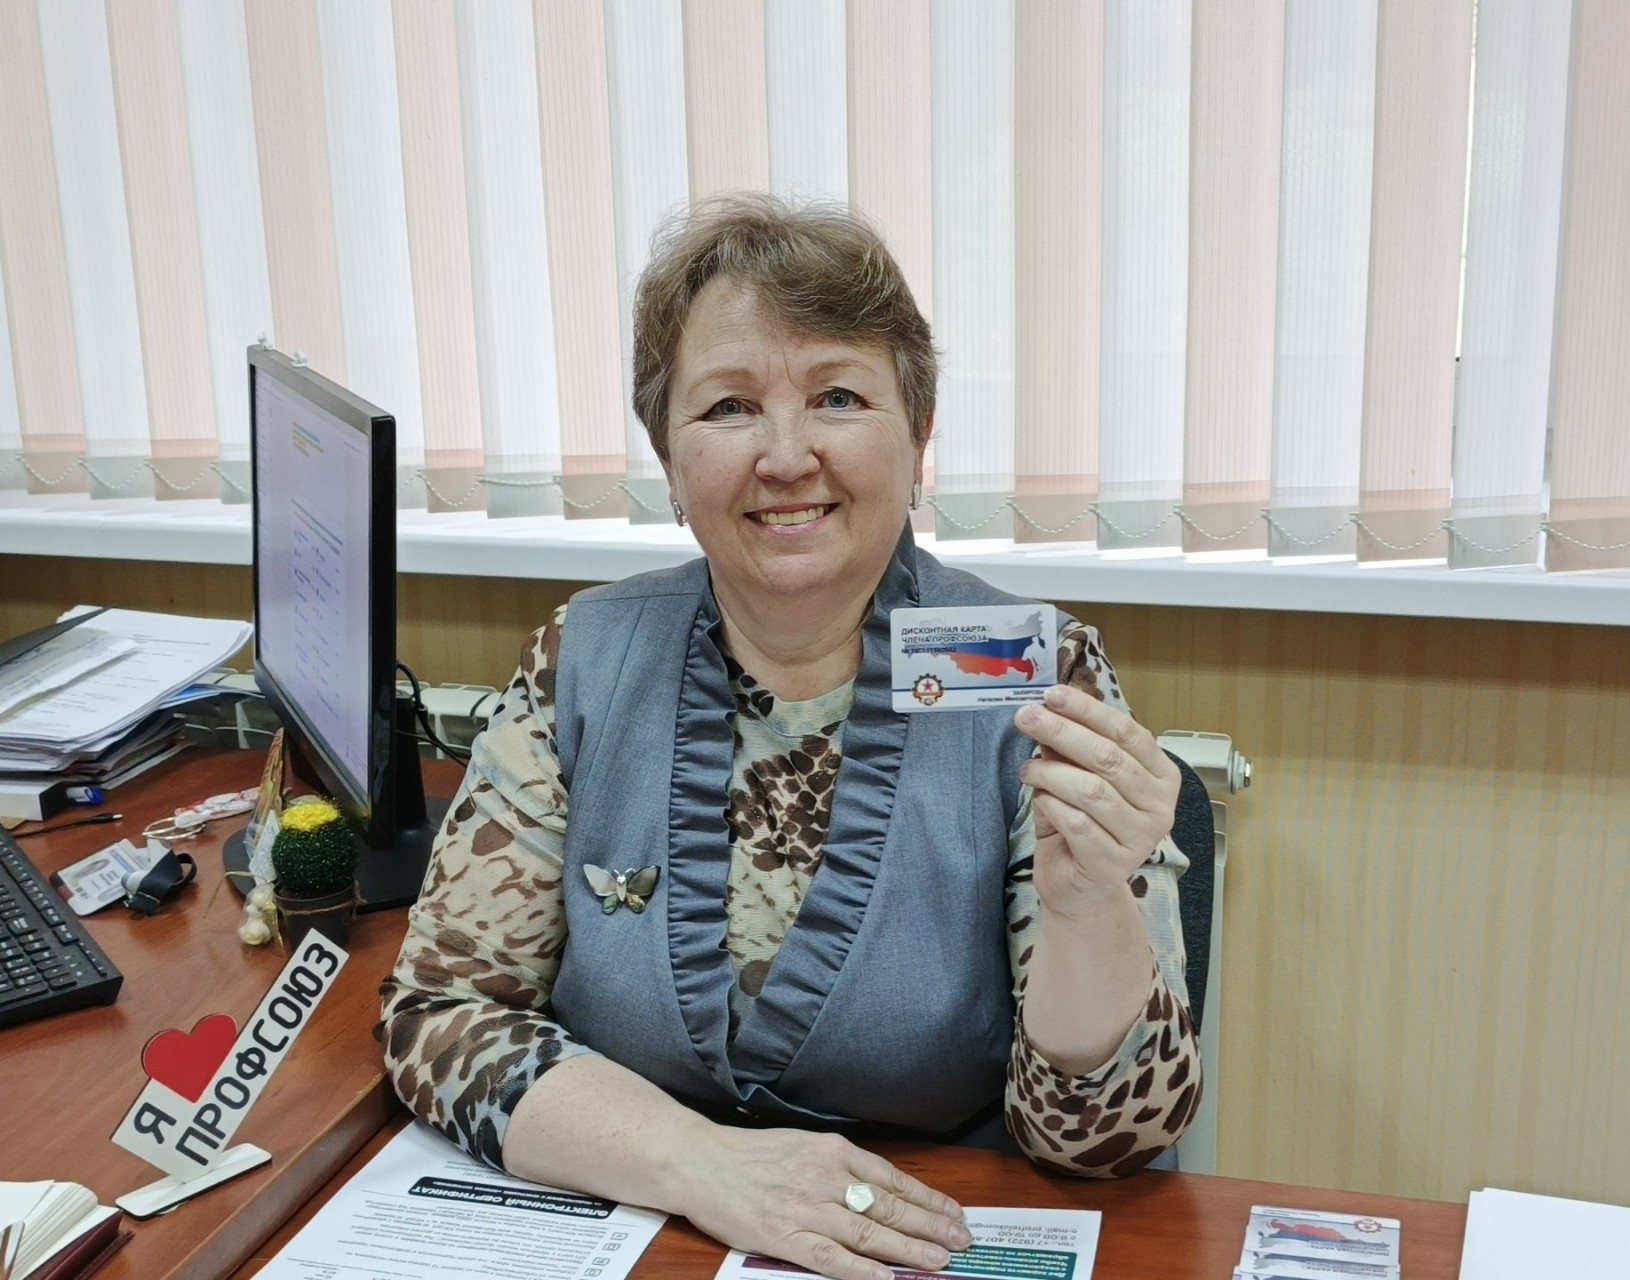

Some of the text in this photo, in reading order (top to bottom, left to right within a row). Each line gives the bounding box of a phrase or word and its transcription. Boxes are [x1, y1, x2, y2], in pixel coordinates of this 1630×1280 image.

[901, 626, 958, 636] ДИСКОНТНАЯ
[902, 635, 988, 644] ЧЛЕНА ПРОФСОЮЗА
[175, 943, 338, 1166] ПРОФСОЮЗ
[134, 1102, 176, 1144] Я
[505, 1197, 608, 1218] ЭЛЕКТРОННЫЙ
